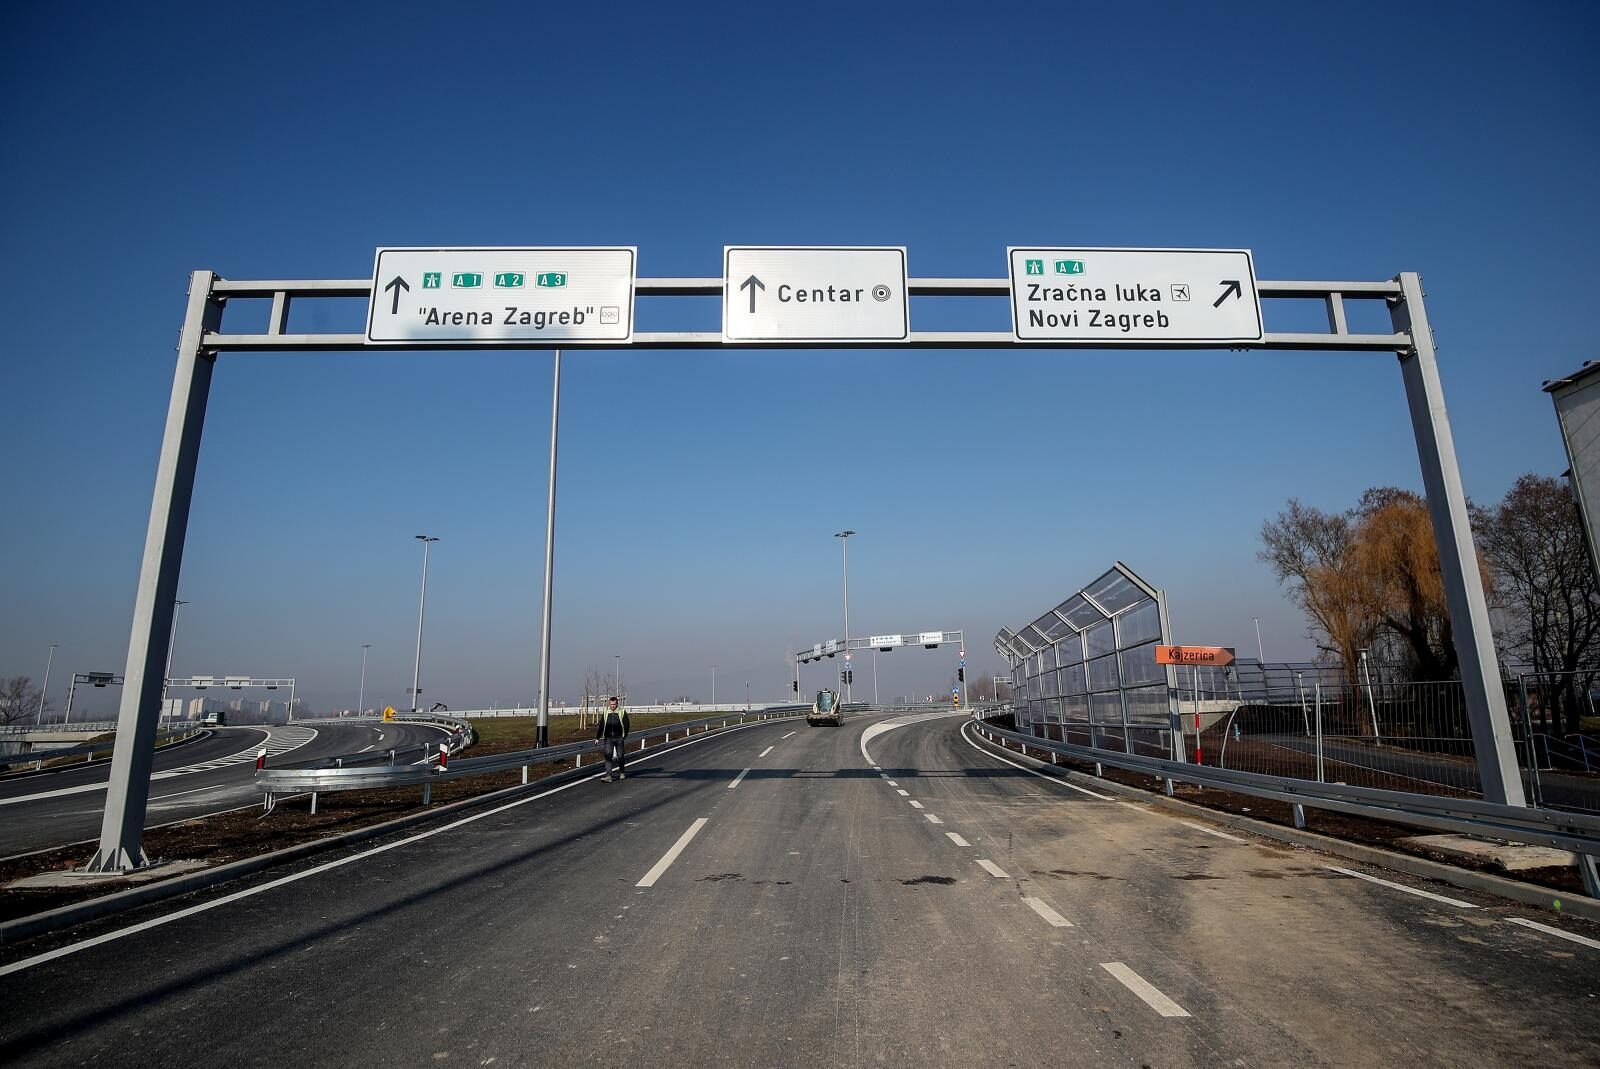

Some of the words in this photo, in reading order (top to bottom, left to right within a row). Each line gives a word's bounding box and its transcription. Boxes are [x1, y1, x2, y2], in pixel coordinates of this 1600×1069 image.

[777, 284, 864, 303] Centar
[1027, 283, 1107, 302] Zračna
[1115, 284, 1162, 302] luka
[418, 307, 493, 326] "Arena
[503, 306, 594, 330] Zagreb"
[1029, 309, 1079, 328] Novi
[1088, 309, 1170, 332] Zagreb
[1168, 648, 1215, 662] Kajzerica
